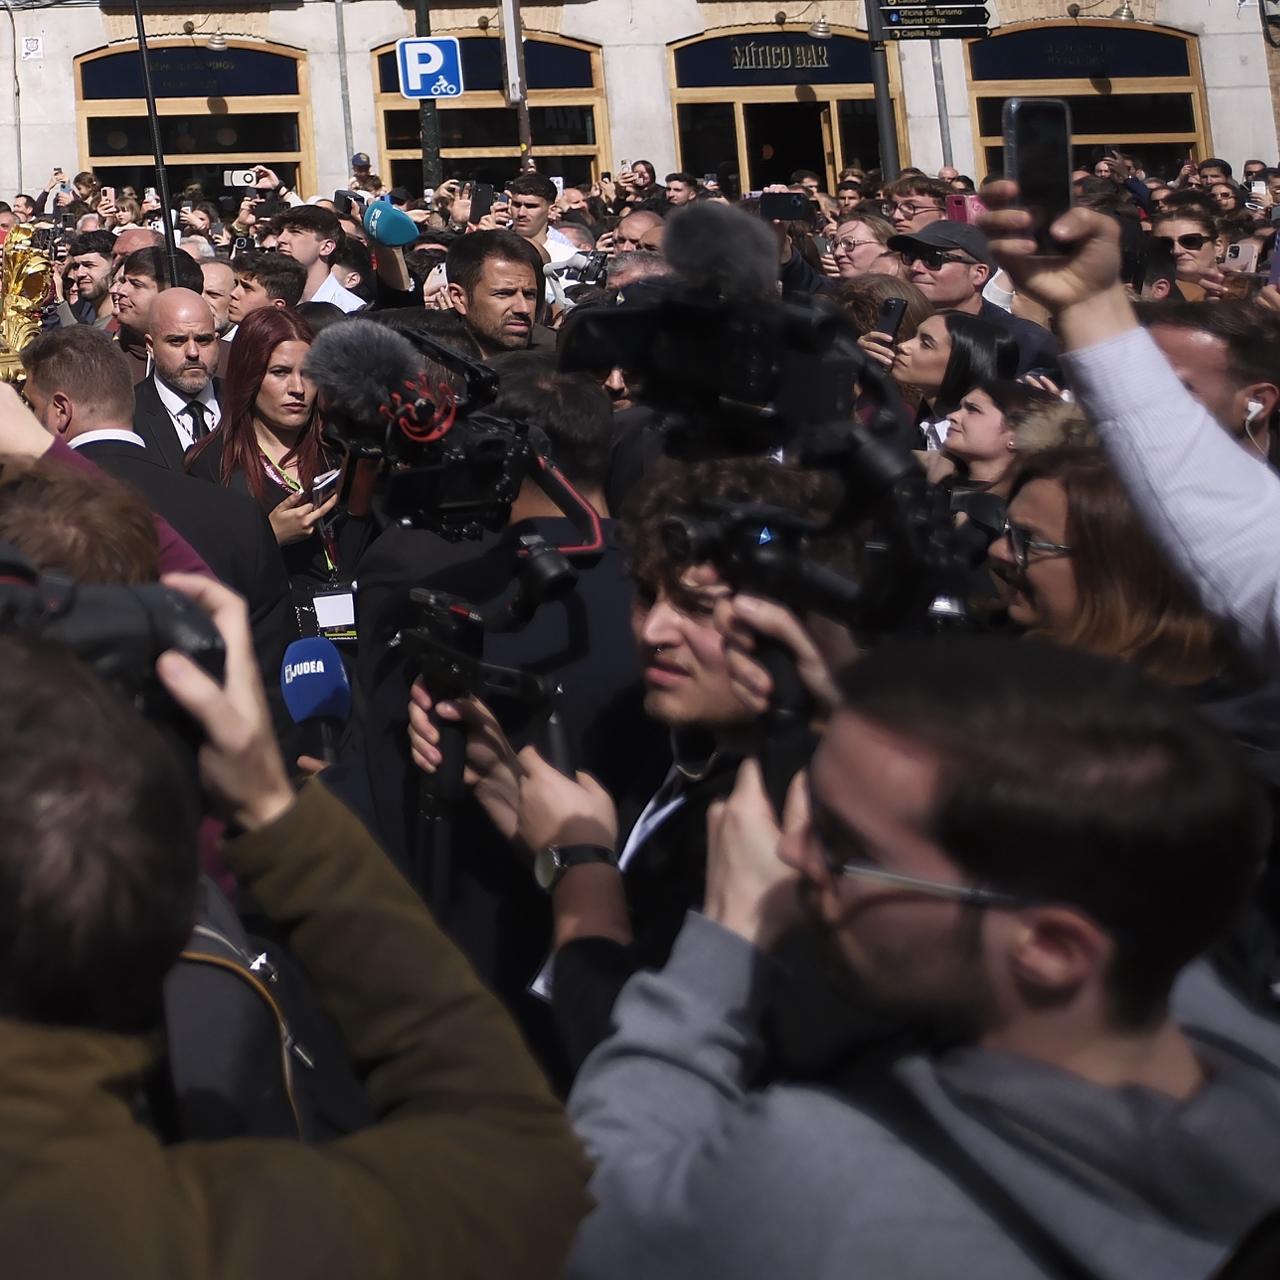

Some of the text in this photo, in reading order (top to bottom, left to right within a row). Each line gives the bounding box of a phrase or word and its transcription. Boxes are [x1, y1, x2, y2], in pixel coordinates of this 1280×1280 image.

[901, 29, 941, 38] Capilla Real
[405, 42, 444, 90] P
[733, 41, 829, 69] MÍTICO BAR
